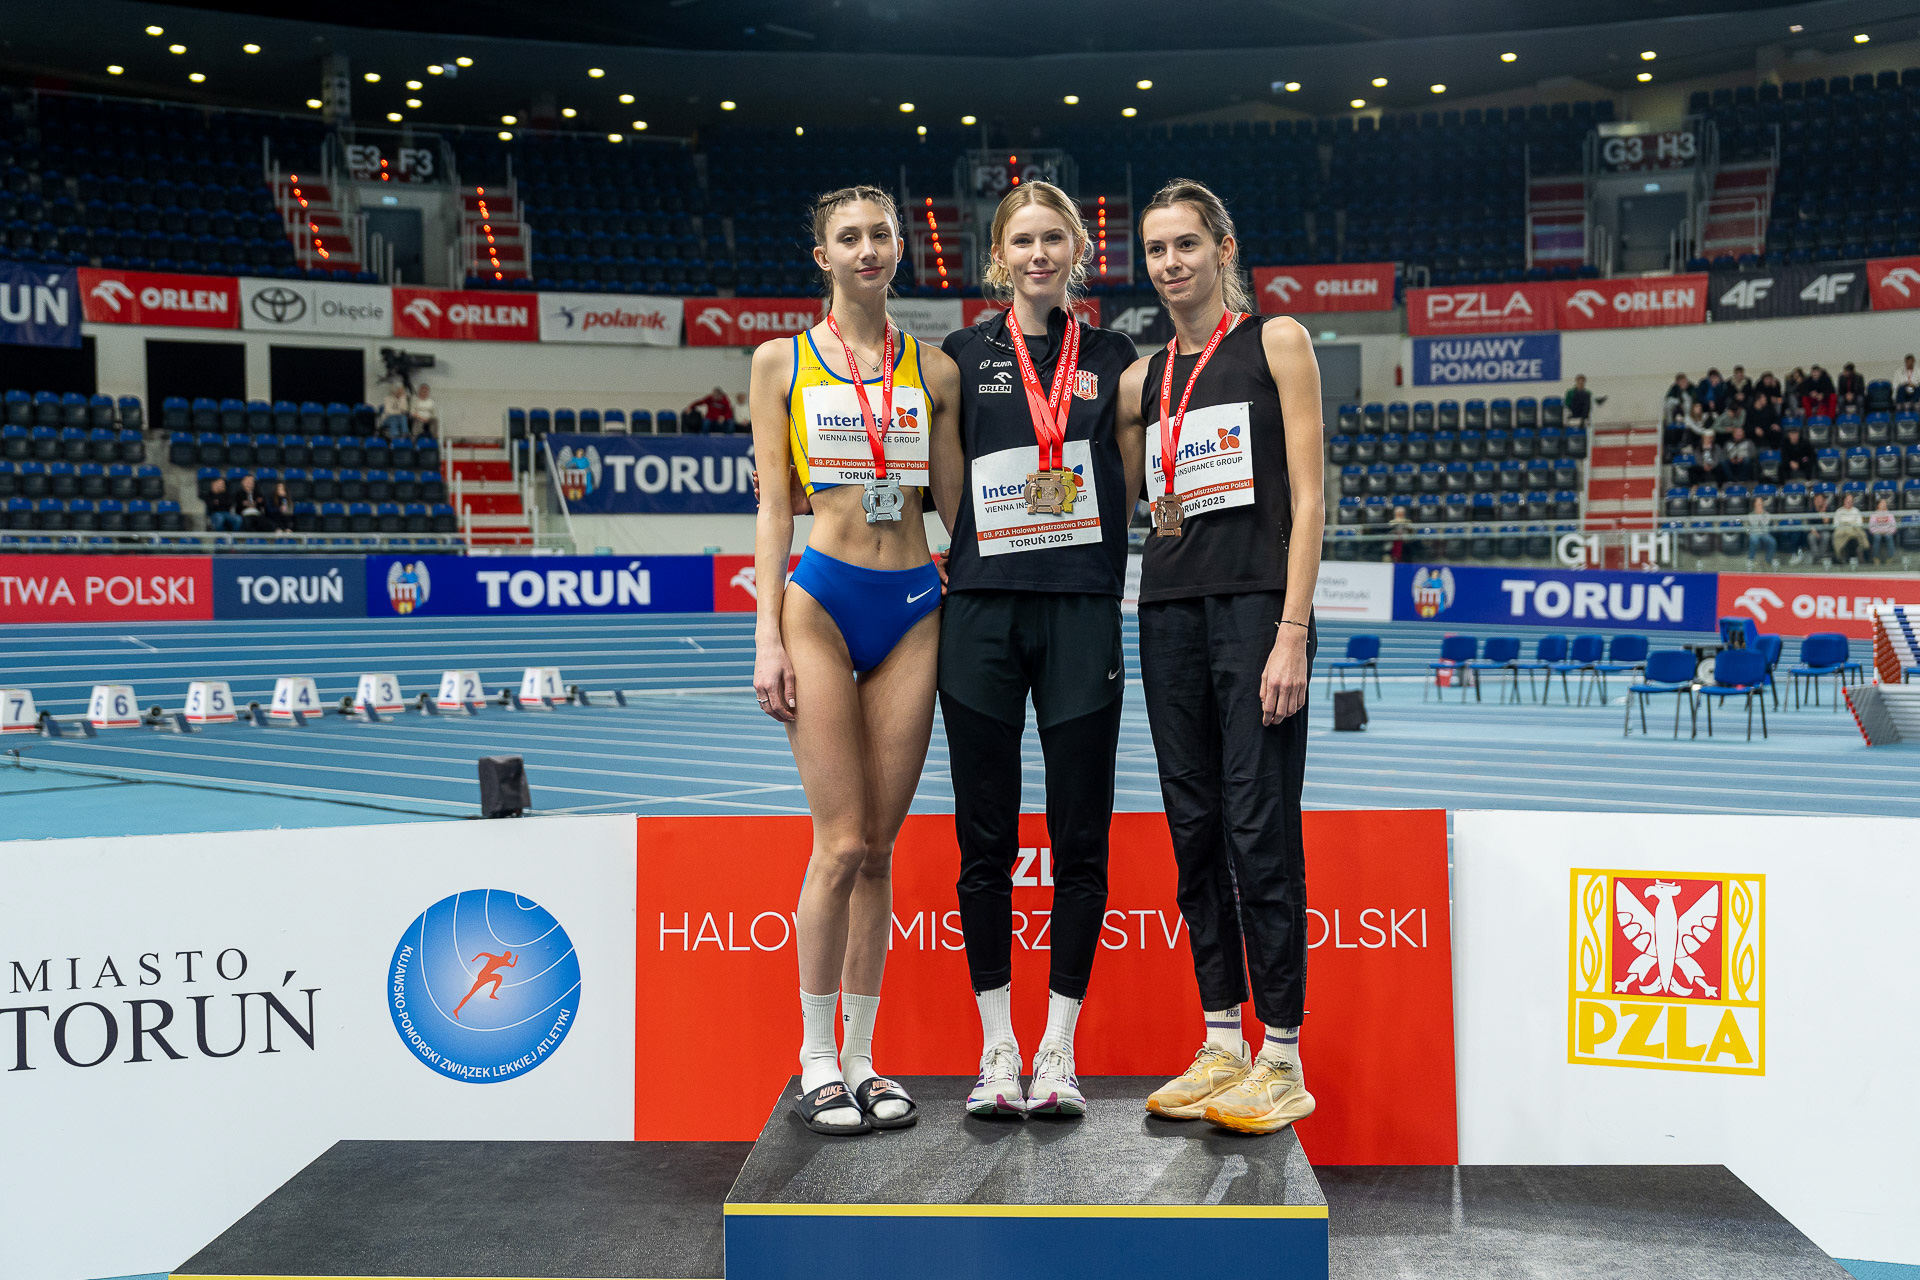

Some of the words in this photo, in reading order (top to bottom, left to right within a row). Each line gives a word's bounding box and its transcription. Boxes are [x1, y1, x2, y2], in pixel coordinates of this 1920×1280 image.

[347, 144, 381, 172] E3
[399, 148, 434, 176] F3
[1603, 137, 1643, 164] G3
[1657, 132, 1696, 160] H3
[977, 165, 1007, 191] F3
[139, 286, 228, 313] ORLEN
[1314, 278, 1378, 297] ORLEN
[1719, 278, 1775, 309] 4F
[1799, 272, 1857, 304] 4F
[321, 299, 384, 321] Okęcie
[1427, 290, 1533, 319] PZLA
[1612, 288, 1696, 314] ORLEN
[447, 303, 529, 327] ORLEN
[581, 309, 667, 332] polanik
[738, 311, 814, 331] ORLEN
[1110, 306, 1159, 334] 4F
[1014, 335, 1037, 384] MISTRZOSTWA
[1190, 329, 1223, 379] MISTRZOSTWA
[1430, 339, 1525, 360] KUJAWY
[884, 344, 893, 392] MISTRZOSTWA
[1053, 364, 1065, 390] POLSKI
[1066, 360, 1076, 384] POLSKI
[1430, 359, 1542, 381] POMORZE
[1049, 390, 1059, 408] 2025
[1063, 384, 1072, 401] 2025
[1180, 379, 1194, 407] POLSKI
[819, 433, 847, 442] VIENNA
[894, 436, 920, 444] GROUP
[825, 459, 841, 467] PZLA
[839, 469, 874, 480] TORUŃ
[1178, 461, 1214, 477] INSURANCE
[1216, 456, 1243, 467] GROUP
[982, 479, 1029, 499] Inter
[1194, 484, 1229, 496] Mistrzostwa
[1231, 480, 1250, 489] Polski
[985, 503, 1014, 513] VIENNA
[1202, 495, 1226, 507] 2025
[995, 529, 1011, 538] PZLA
[1011, 527, 1036, 536] Halowe
[1037, 521, 1076, 533] Mistrzostwa
[1077, 518, 1096, 528] Polski
[1009, 534, 1046, 548] TORUŃ
[1048, 532, 1074, 543] 2025
[1557, 532, 1600, 567] G1
[1630, 531, 1671, 565] H1
[85, 574, 195, 606] POLSKI
[237, 567, 344, 605] TORUŃ
[476, 560, 652, 608] TORUŃ
[1501, 576, 1684, 623] TORUŃ
[299, 686, 310, 706] 4
[381, 682, 393, 701] 3
[464, 679, 476, 698] 2
[546, 676, 554, 693] 1
[10, 699, 25, 721] 7
[115, 694, 129, 716] 6
[212, 690, 225, 711] 5
[1011, 847, 1054, 886] ZL
[660, 911, 798, 951] HALO
[1305, 908, 1427, 949] OLSKI
[9, 948, 248, 993] MIASTO
[0, 969, 322, 1072] TORUŃ
[393, 944, 441, 1064] KUJAWSKO-POMORSKI
[440, 1058, 490, 1079] ZWIĄZEK
[493, 1050, 538, 1077] LEKKIEJ
[537, 1008, 571, 1056] ATLETYKI
[1578, 1000, 1754, 1064] PZLA
[819, 1084, 843, 1099] NIKE
